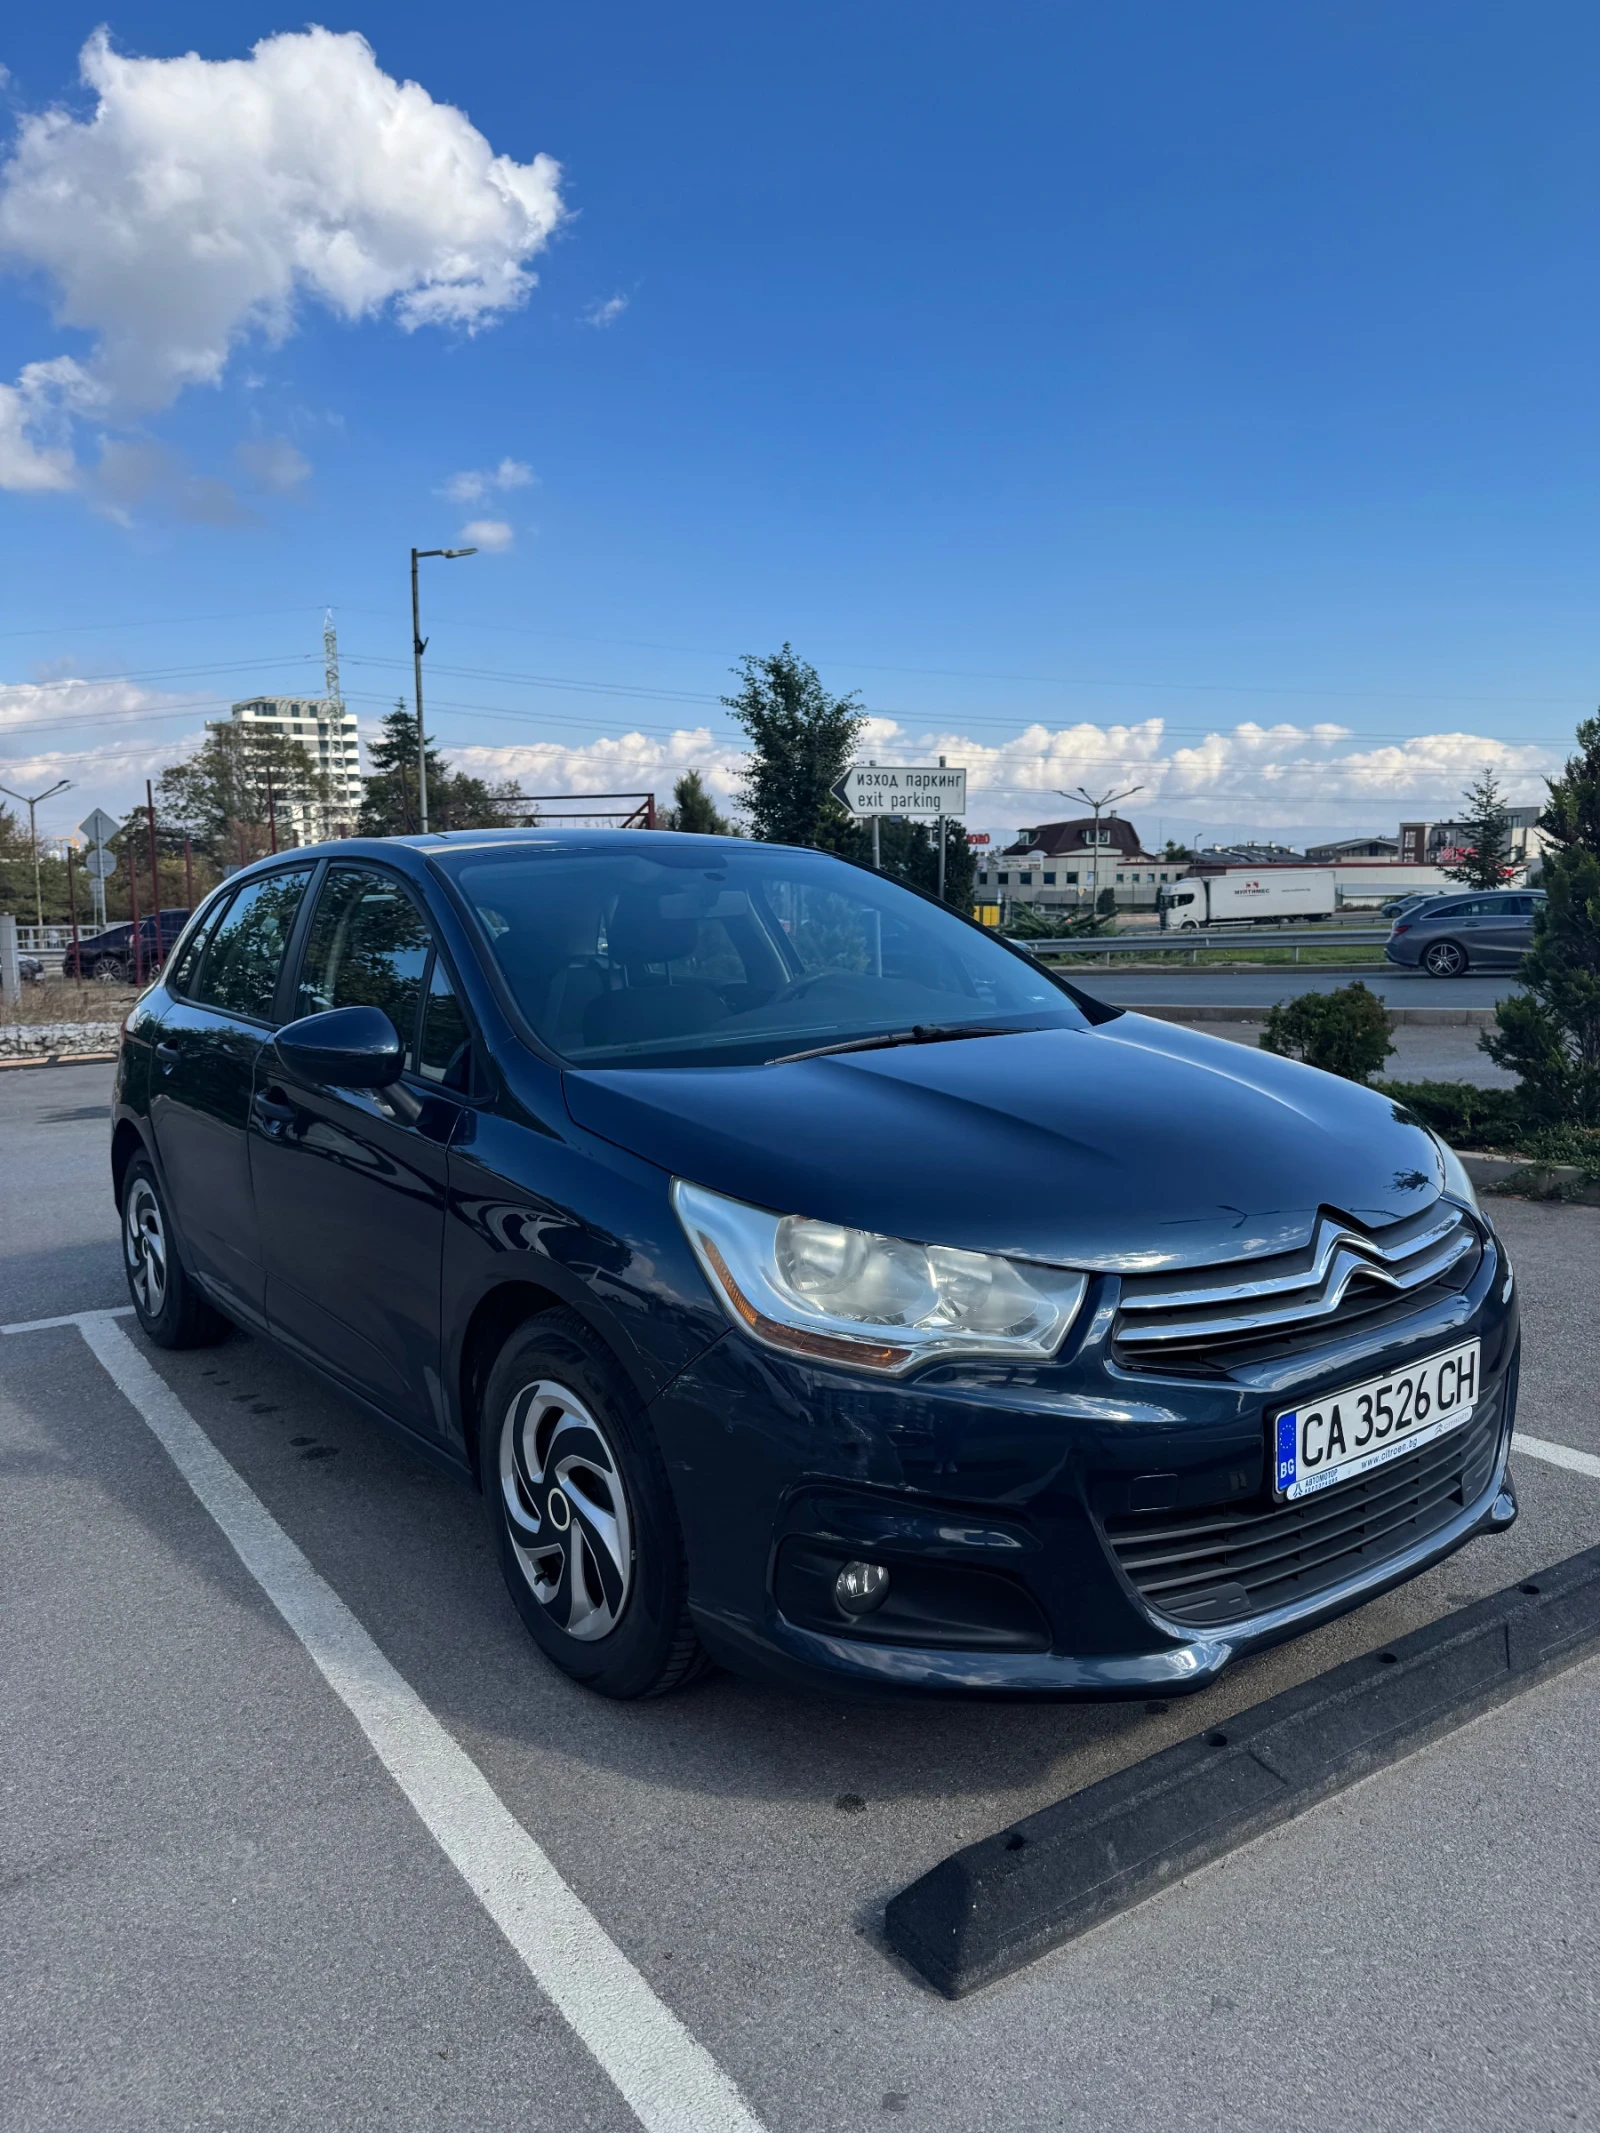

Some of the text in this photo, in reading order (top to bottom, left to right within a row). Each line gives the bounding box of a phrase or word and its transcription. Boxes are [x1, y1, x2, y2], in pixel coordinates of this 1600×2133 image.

[857, 774, 961, 791] изход паркинг
[858, 792, 941, 812] exit parking
[1302, 1351, 1475, 1467] CA 3526 CH
[1361, 1438, 1418, 1469] www.citroen.bg
[1280, 1458, 1295, 1478] BG
